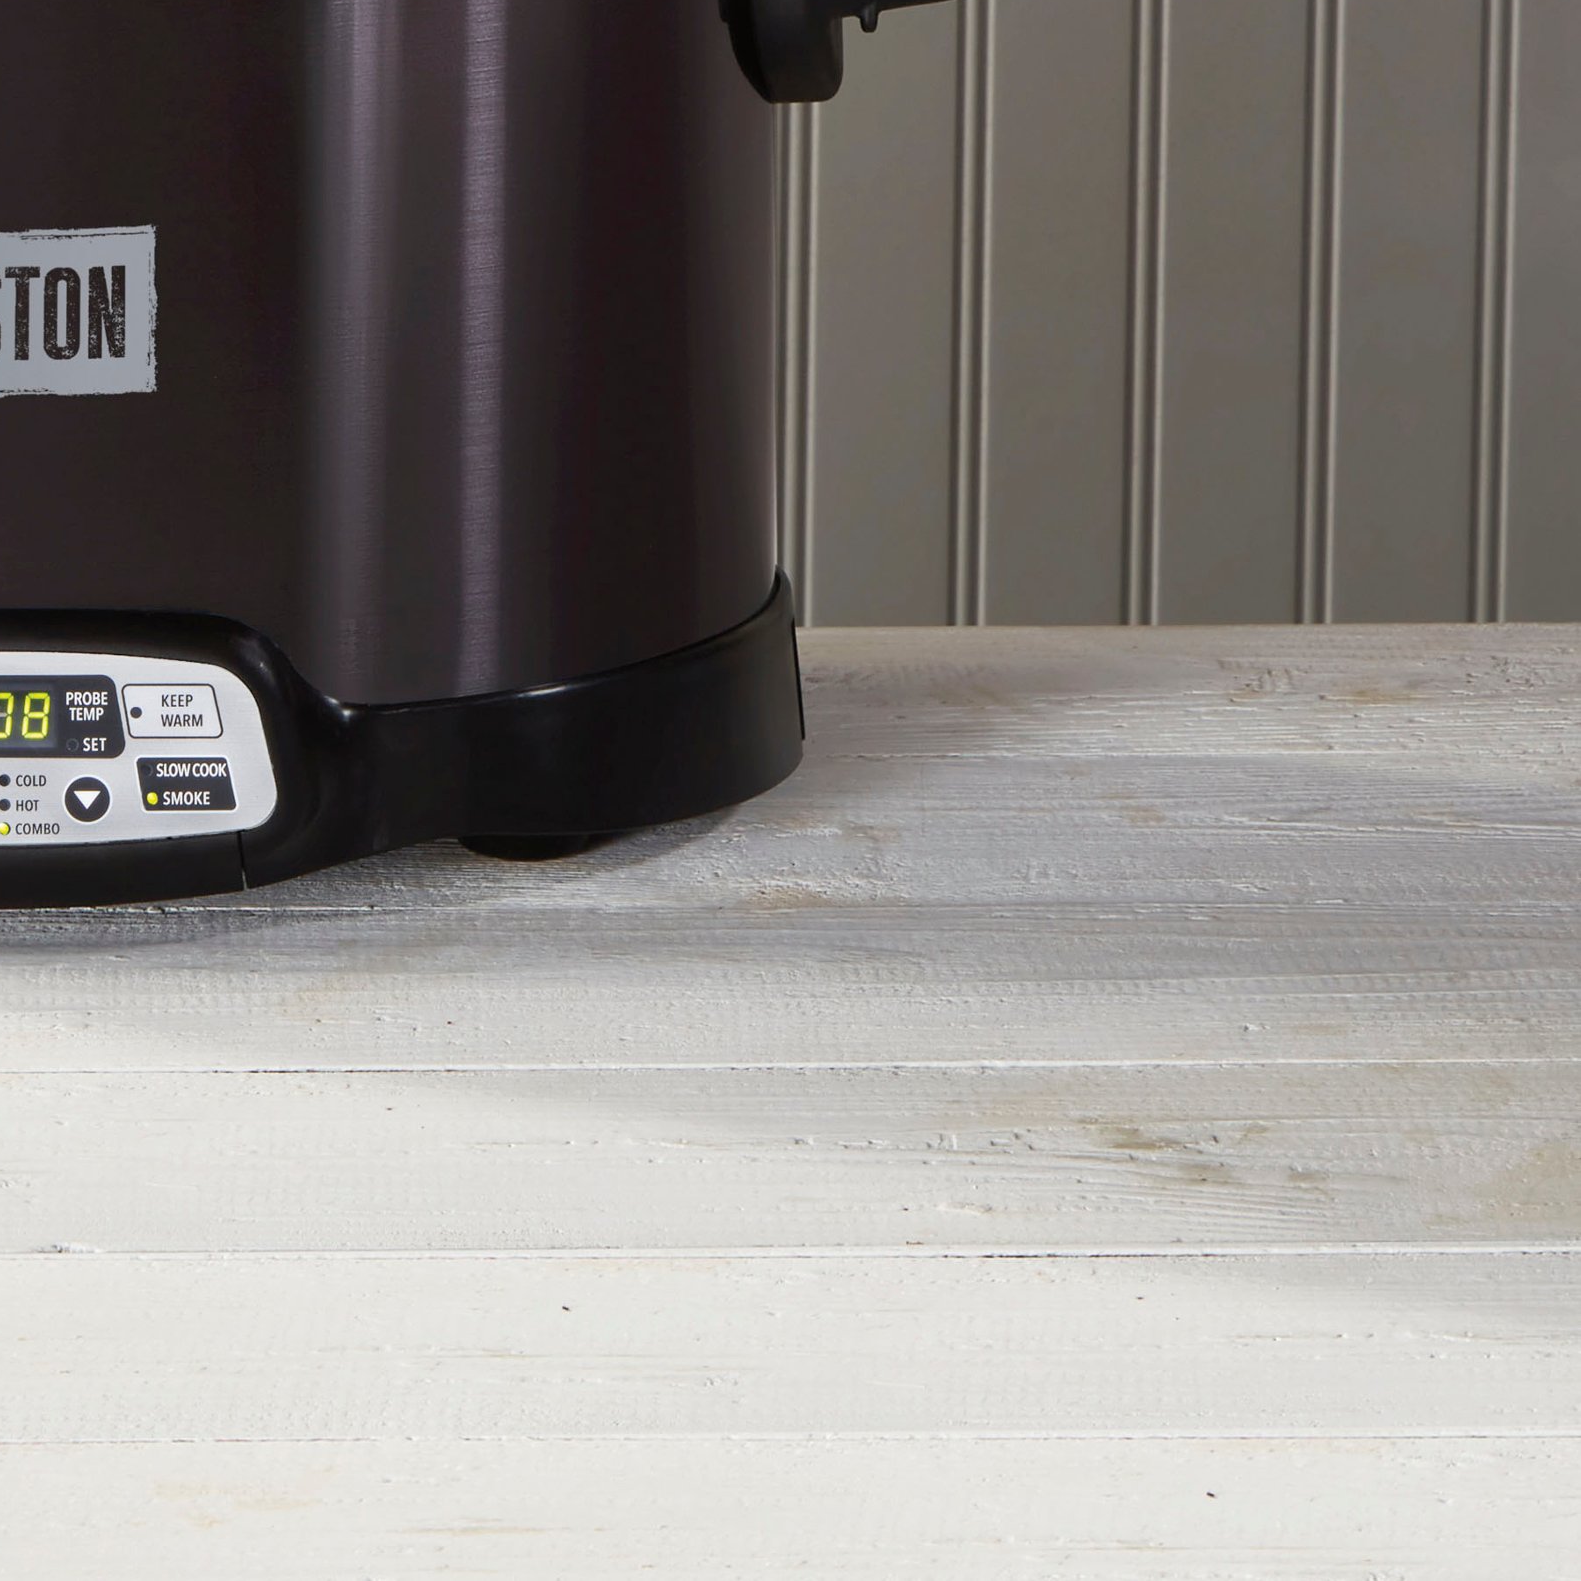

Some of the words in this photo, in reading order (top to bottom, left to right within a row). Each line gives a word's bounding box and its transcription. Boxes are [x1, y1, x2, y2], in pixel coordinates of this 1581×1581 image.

[65, 691, 108, 706] PROBE
[161, 694, 193, 707] KEEP
[69, 707, 104, 721] TEMP
[161, 714, 203, 727] WARM
[82, 737, 107, 752] SET
[156, 763, 191, 777] SLOW
[192, 763, 227, 777] COOK
[15, 775, 47, 787] COLD
[162, 791, 211, 805] SMOKE
[15, 800, 40, 812] HOT
[15, 823, 60, 835] COMBO
